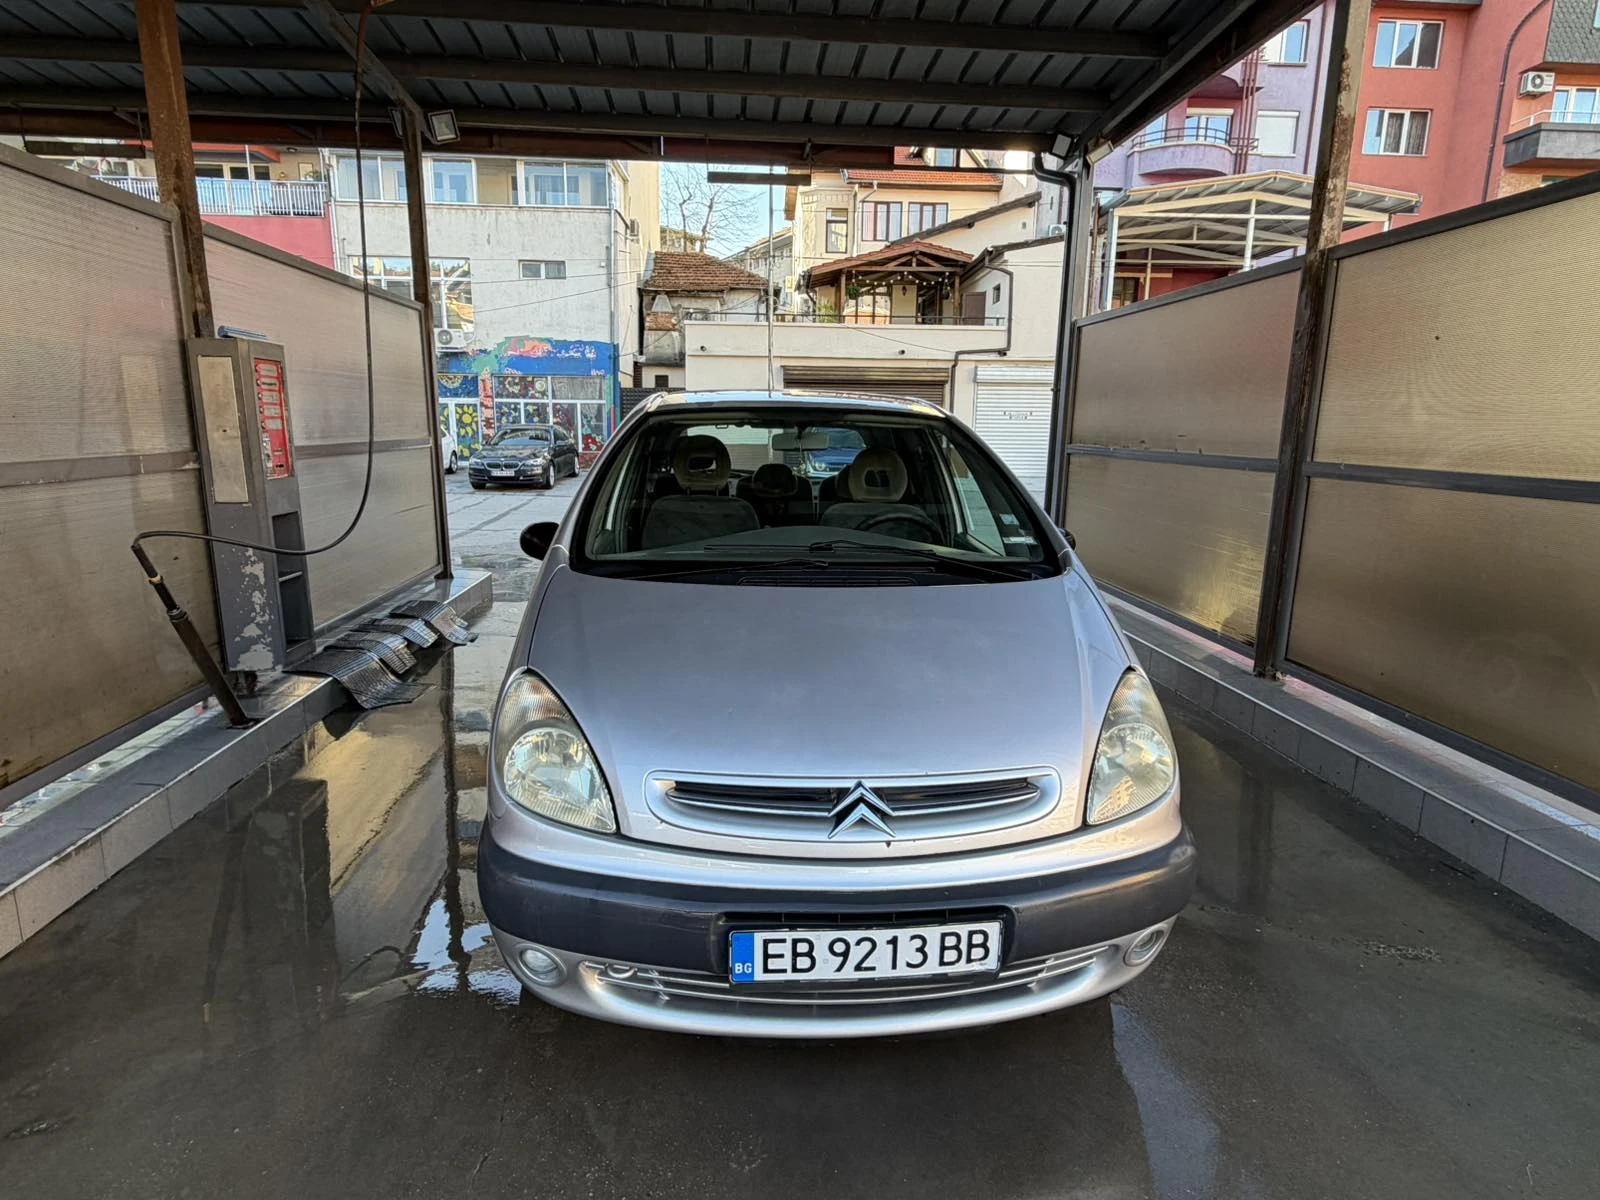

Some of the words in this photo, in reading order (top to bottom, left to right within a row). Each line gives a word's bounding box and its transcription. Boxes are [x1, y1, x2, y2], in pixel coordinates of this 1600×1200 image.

[762, 937, 817, 975] EB
[828, 934, 929, 973] 9213
[938, 929, 990, 967] BB
[735, 962, 753, 974] BG
